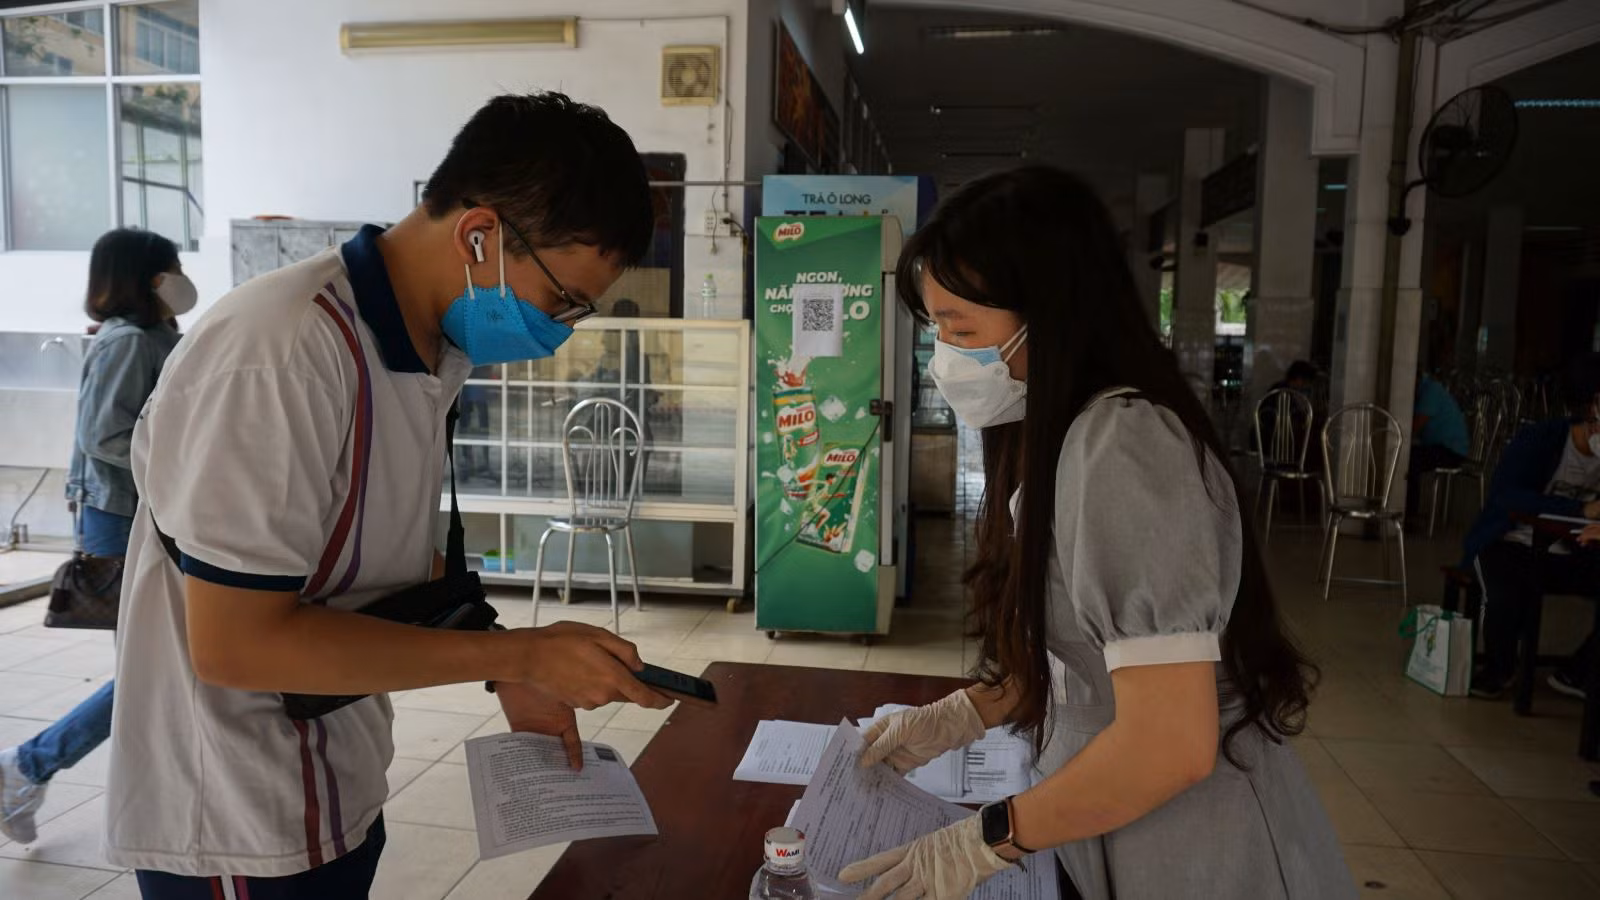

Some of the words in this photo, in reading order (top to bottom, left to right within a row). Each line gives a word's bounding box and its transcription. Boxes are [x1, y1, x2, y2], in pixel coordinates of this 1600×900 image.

[802, 192, 825, 204] TRÀ
[827, 192, 837, 204] Ô
[840, 194, 871, 205] LONG
[778, 226, 801, 237] MILO
[796, 271, 842, 283] NGON,
[765, 284, 793, 300] NĂ
[842, 284, 873, 297] ƠNG
[769, 303, 793, 314] CHỌ
[778, 410, 814, 428] MILO
[826, 453, 856, 462] MILO
[776, 848, 799, 857] WAMI
